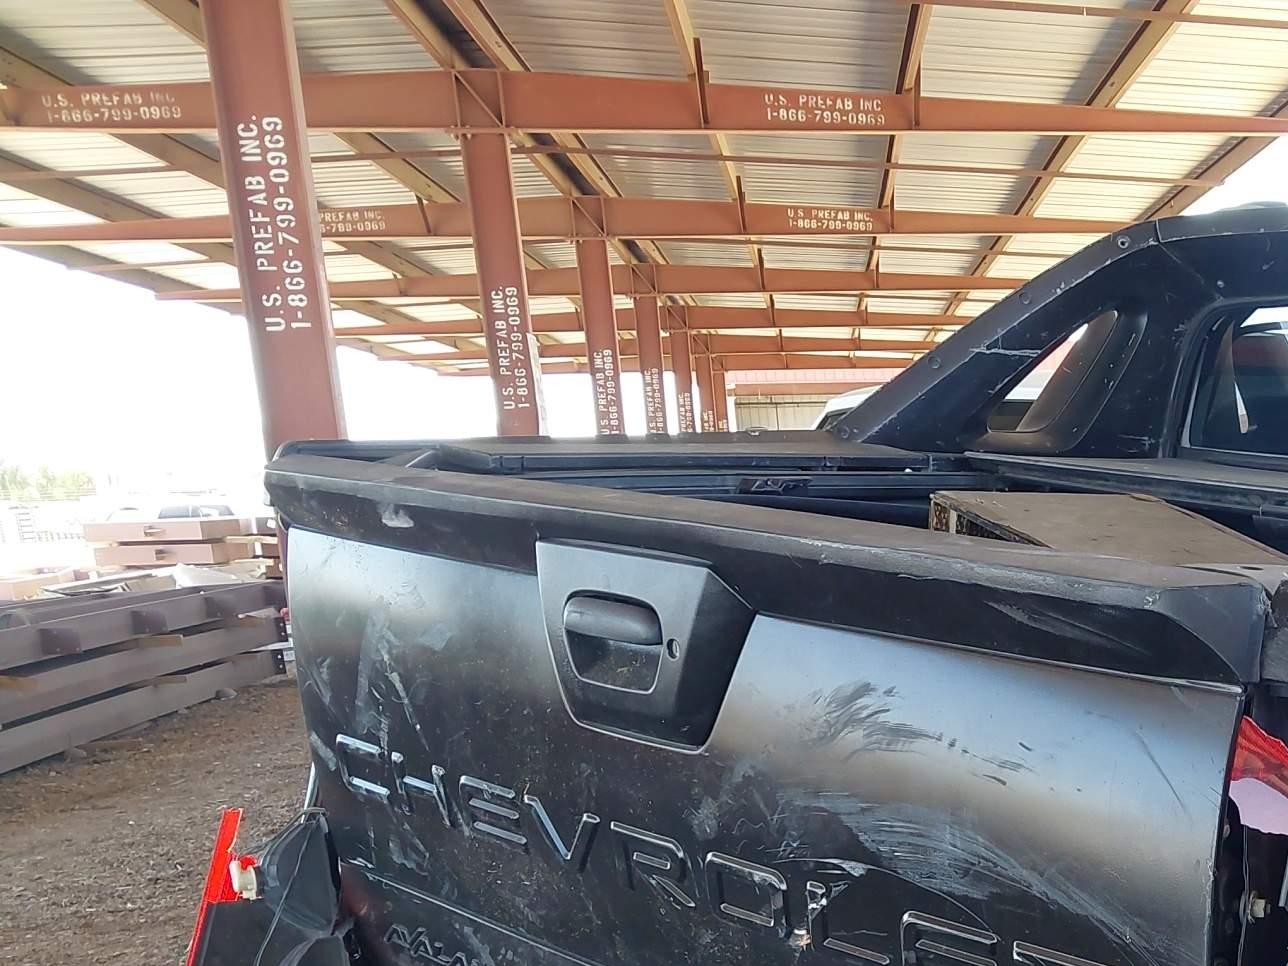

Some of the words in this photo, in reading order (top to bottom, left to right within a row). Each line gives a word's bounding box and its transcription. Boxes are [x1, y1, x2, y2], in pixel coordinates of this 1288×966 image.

[766, 107, 885, 125] 1-866-799-0969
[799, 94, 854, 111] PREFAB
[237, 115, 262, 162] INC.
[245, 175, 278, 271] PREFAB
[262, 116, 312, 329] 1-866-799-0969
[262, 285, 286, 332] U.S.
[491, 286, 505, 313] INC.
[495, 320, 512, 376] PREFAB
[505, 286, 530, 409] 1-866-799-0969
[502, 382, 515, 410] U.S.
